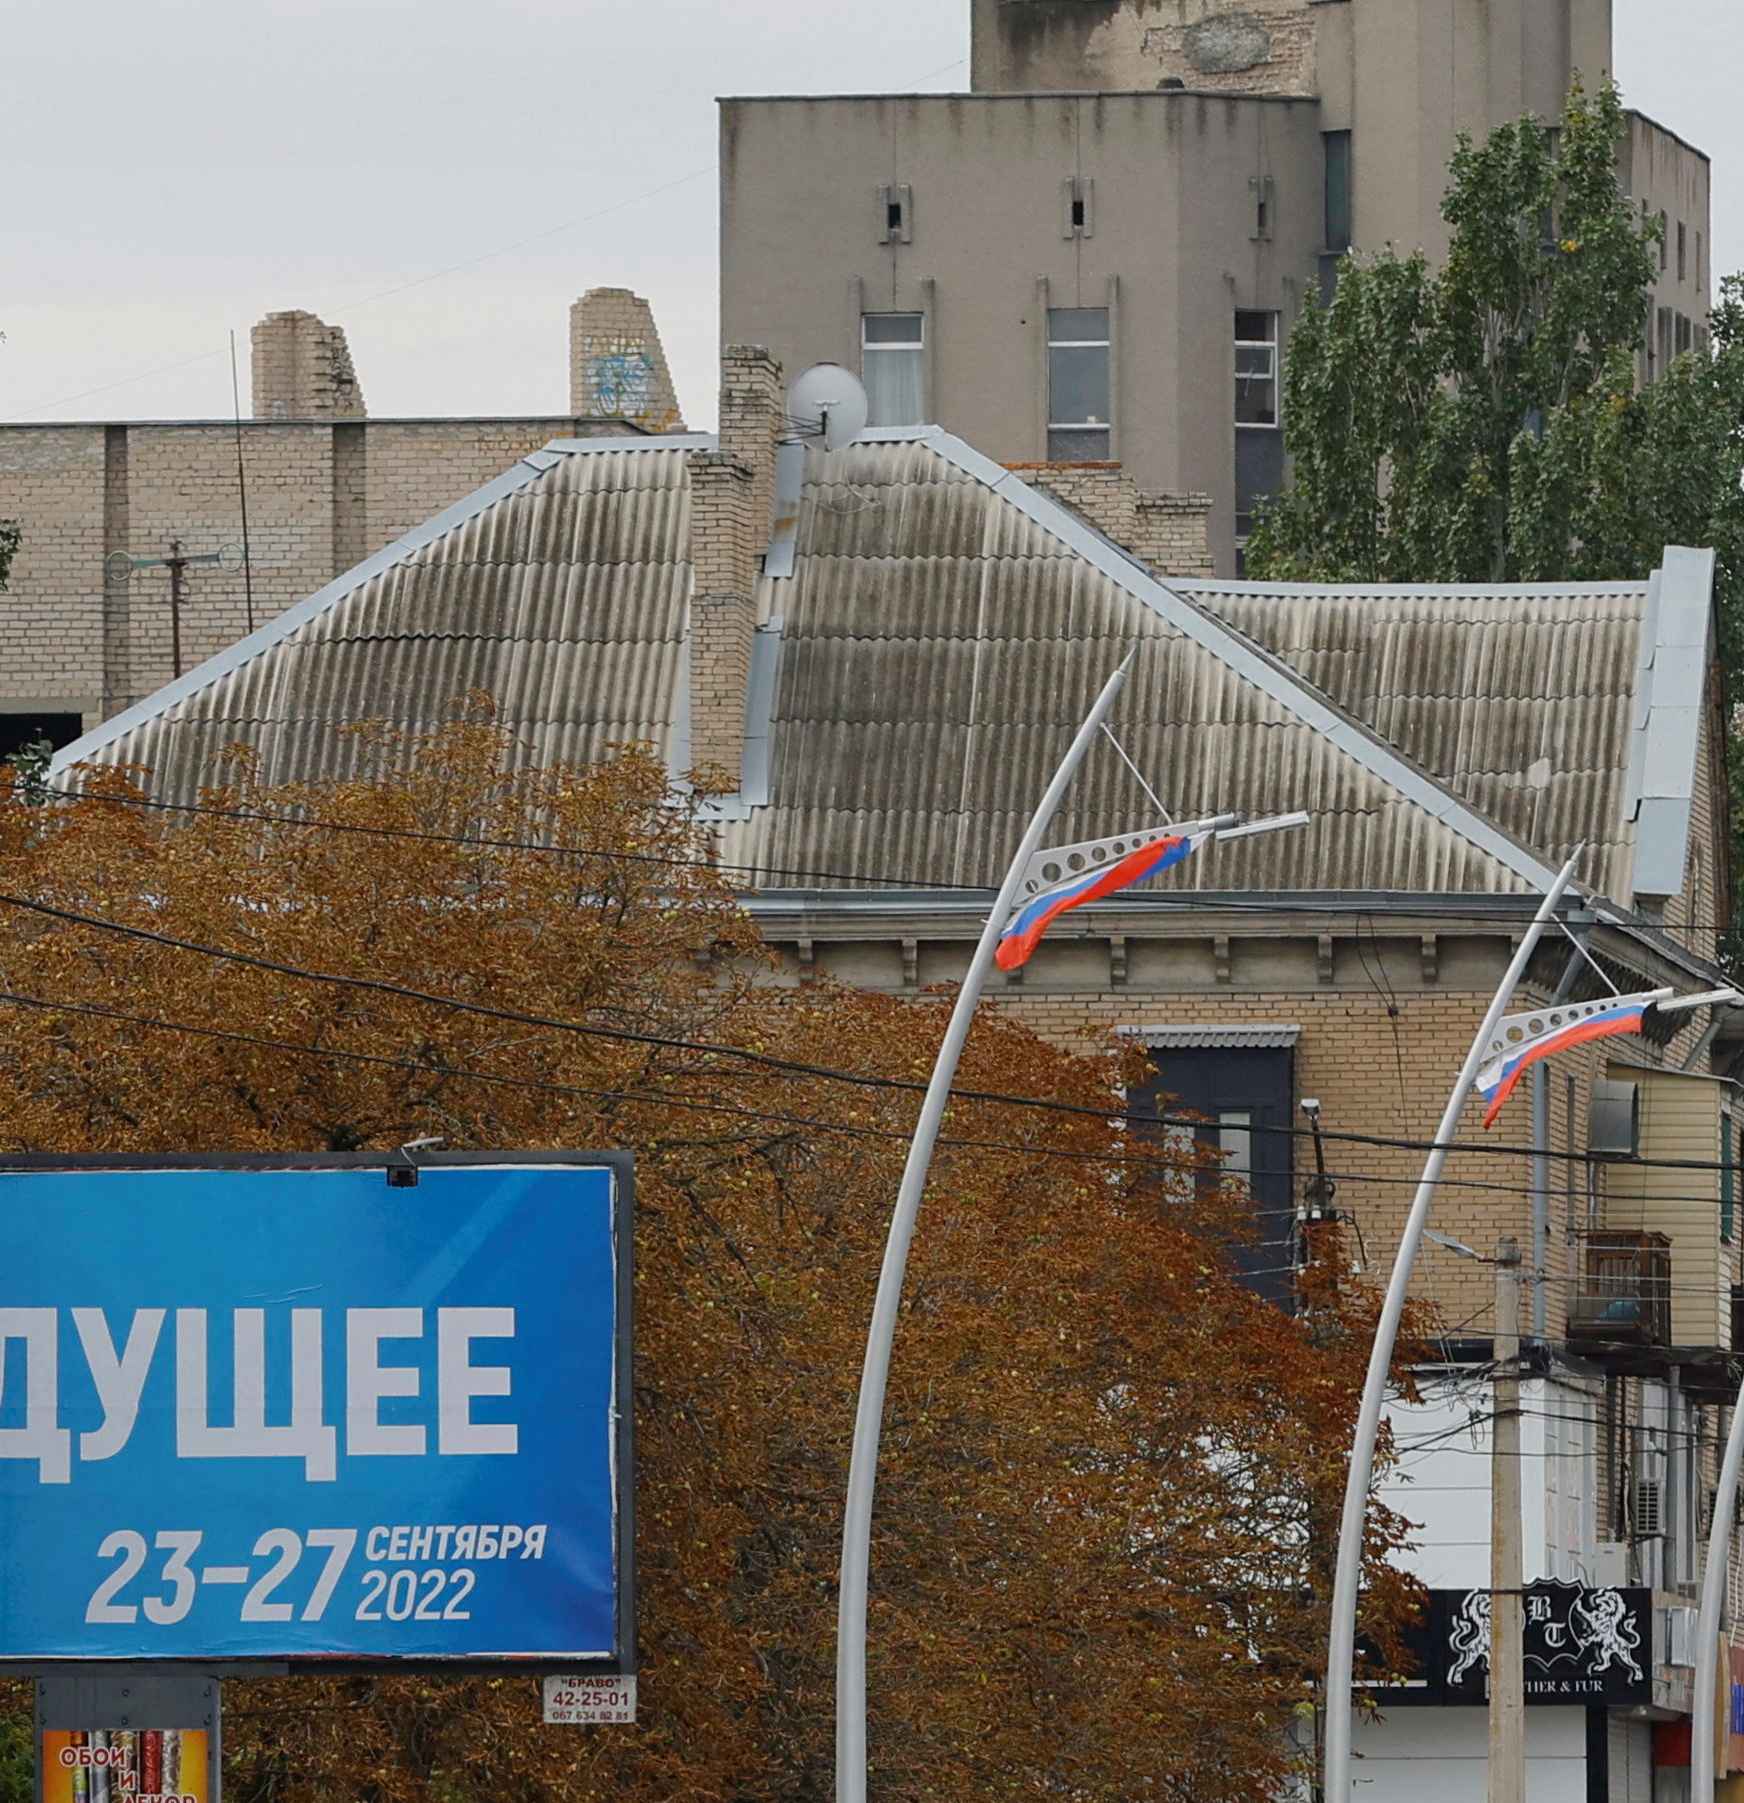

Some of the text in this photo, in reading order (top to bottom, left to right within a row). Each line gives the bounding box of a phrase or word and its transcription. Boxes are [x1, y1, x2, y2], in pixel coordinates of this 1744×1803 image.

[365, 1524, 548, 1561] СЕНТЯБРЯ
[355, 1569, 475, 1621] 2022
[561, 1678, 622, 1688] "БРАВО"
[1575, 1680, 1604, 1693] FUR
[552, 1691, 629, 1706] 42-25-01
[552, 1711, 573, 1721] 067
[60, 1748, 127, 1767] ОБОИ
[119, 1769, 136, 1791] И
